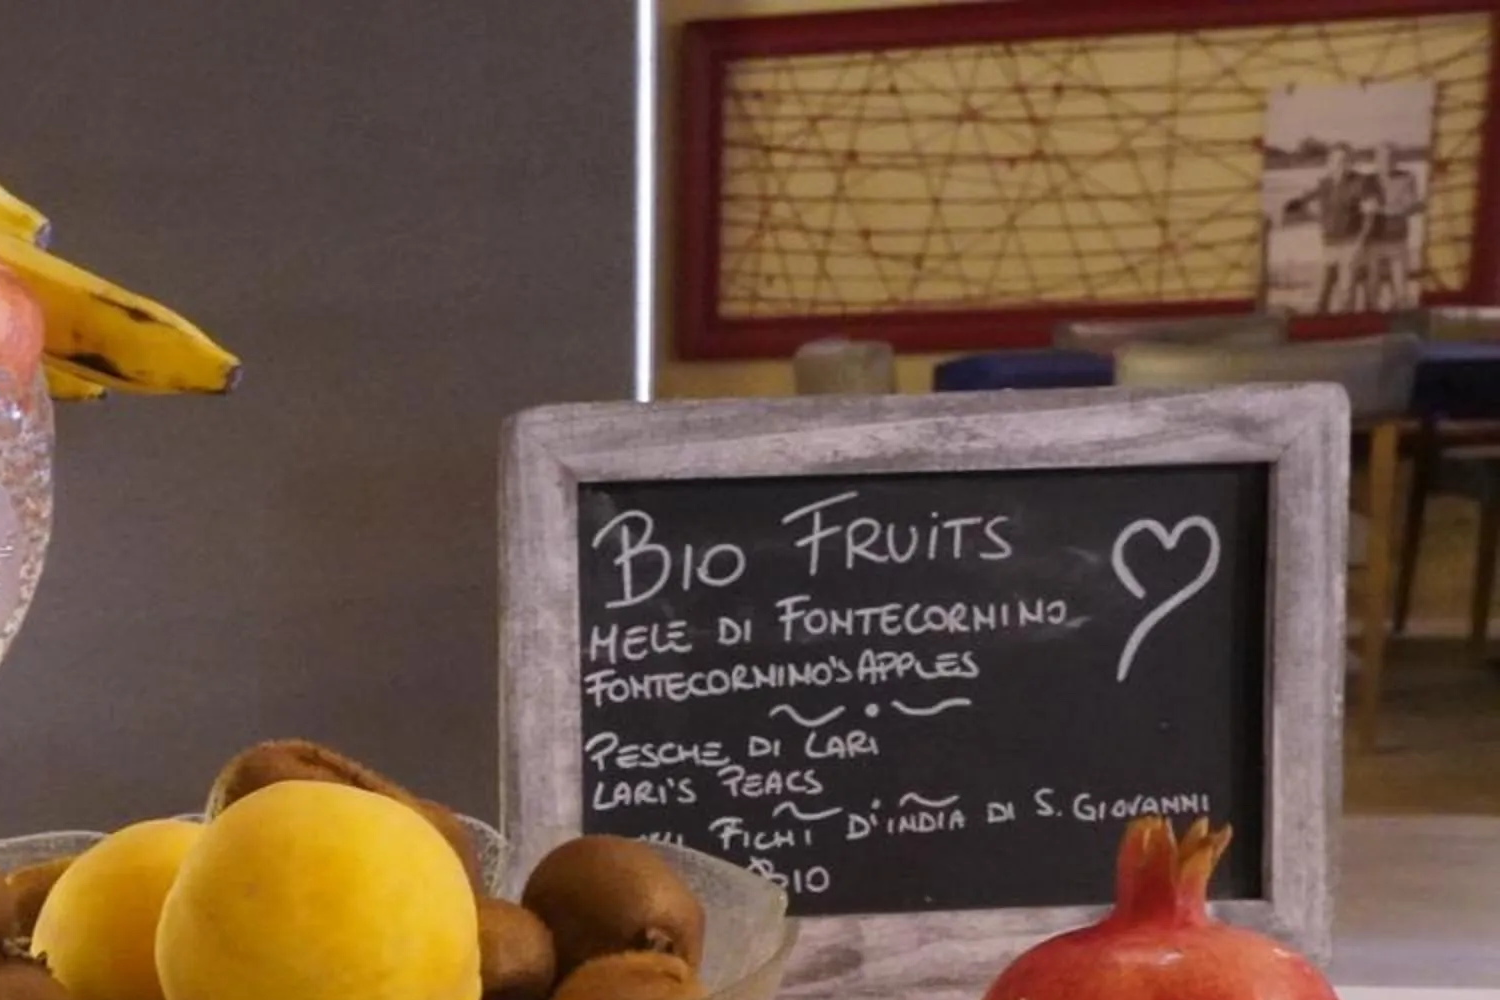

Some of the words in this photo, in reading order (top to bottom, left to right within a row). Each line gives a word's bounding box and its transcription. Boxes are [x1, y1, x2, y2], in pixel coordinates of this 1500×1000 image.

[591, 509, 747, 609] BIO
[717, 616, 752, 646] DI
[857, 648, 980, 685] APPLES
[584, 731, 731, 771] PESCHE
[748, 735, 781, 757] DI
[804, 729, 880, 759] LARI
[592, 777, 697, 811] LARI'S
[717, 765, 824, 797] PEACS
[708, 816, 813, 850] FICHI
[987, 801, 1017, 824] DI
[1033, 787, 1063, 817] S.
[1072, 792, 1211, 822] GIOVANNI
